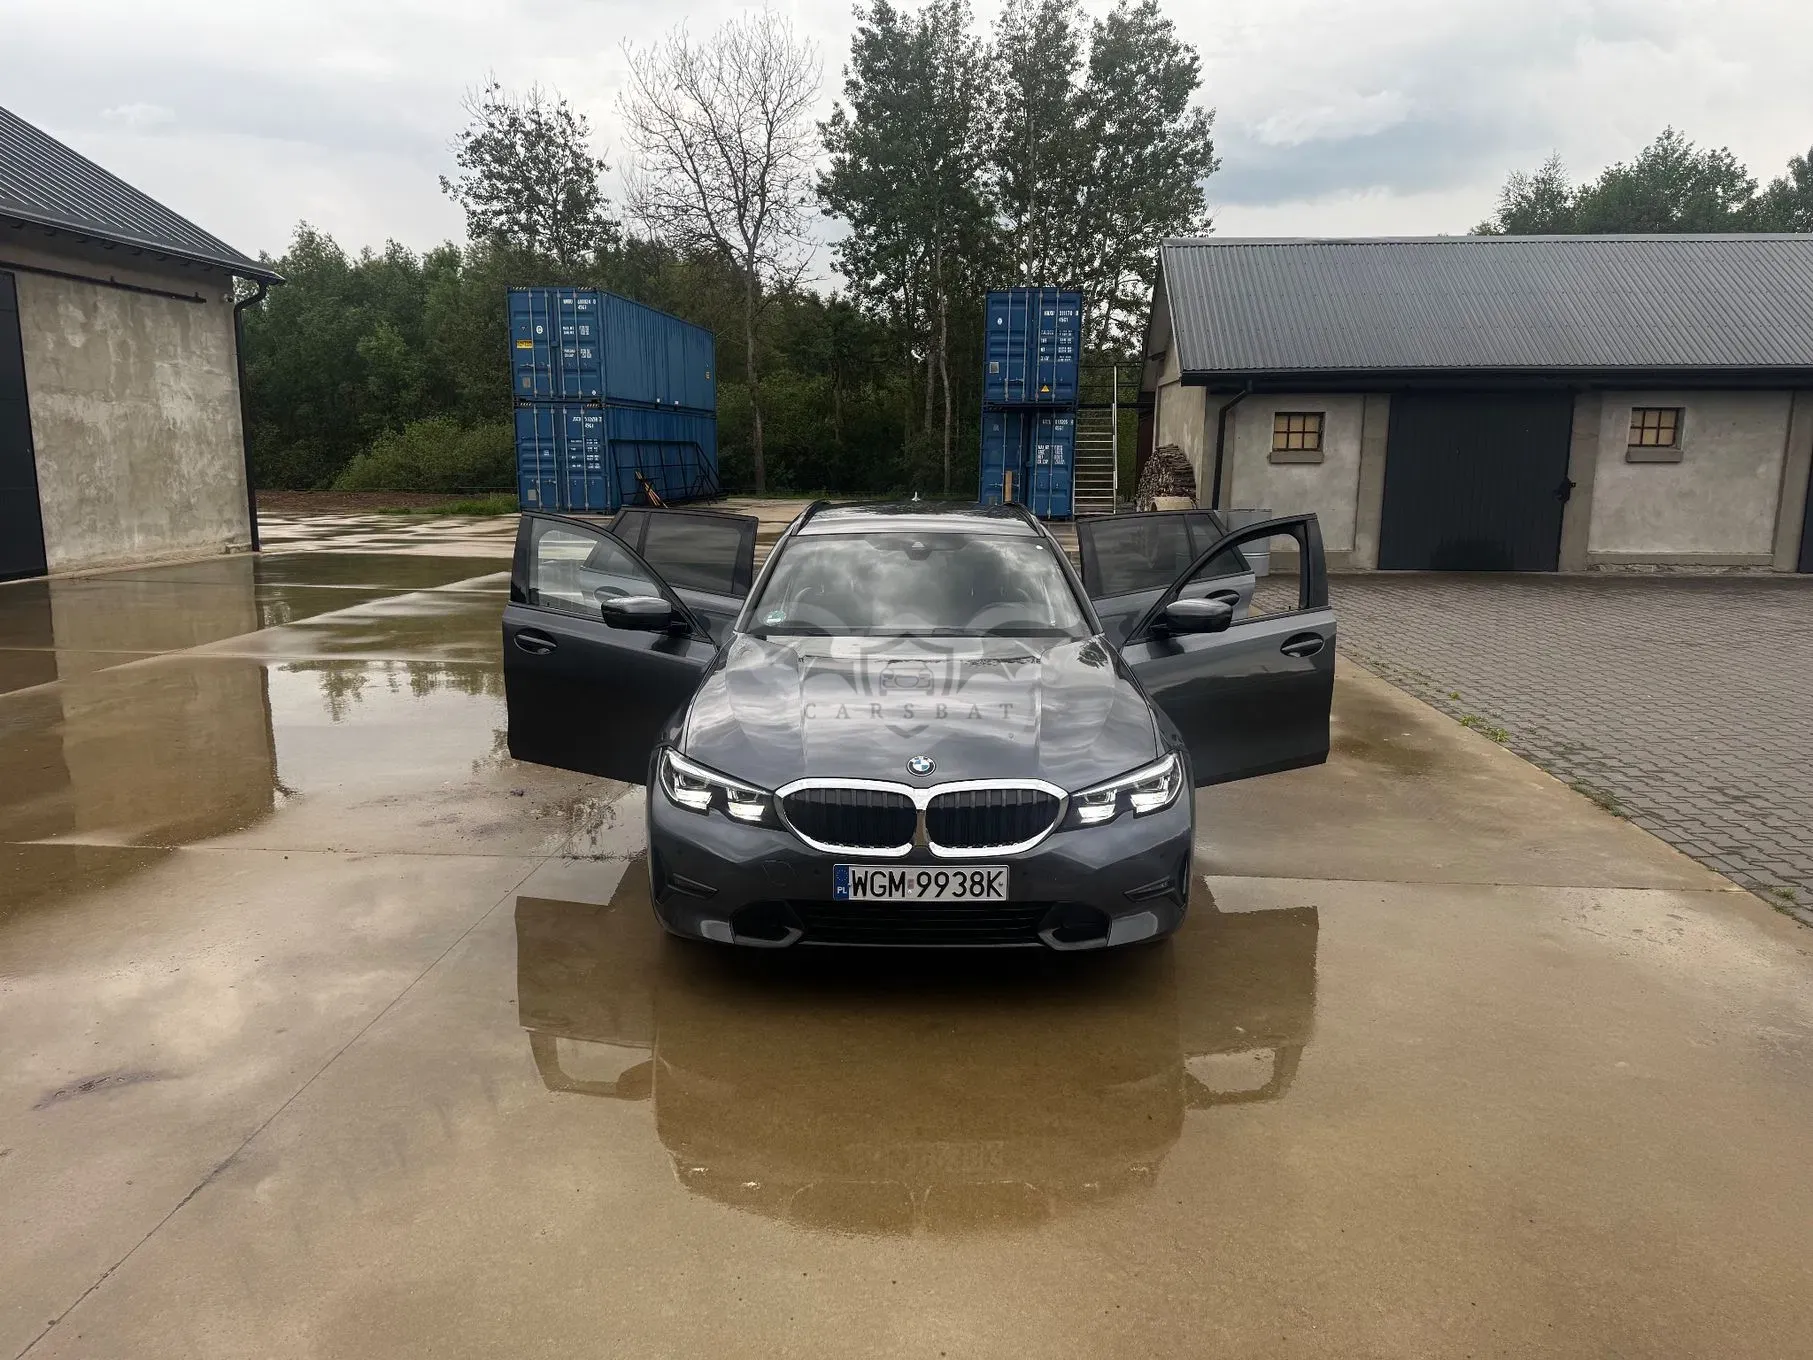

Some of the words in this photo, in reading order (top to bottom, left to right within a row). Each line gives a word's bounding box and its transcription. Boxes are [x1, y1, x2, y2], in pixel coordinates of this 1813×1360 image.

[836, 886, 848, 894] PL
[851, 870, 906, 898] WGM
[916, 870, 1004, 898] 9938K
